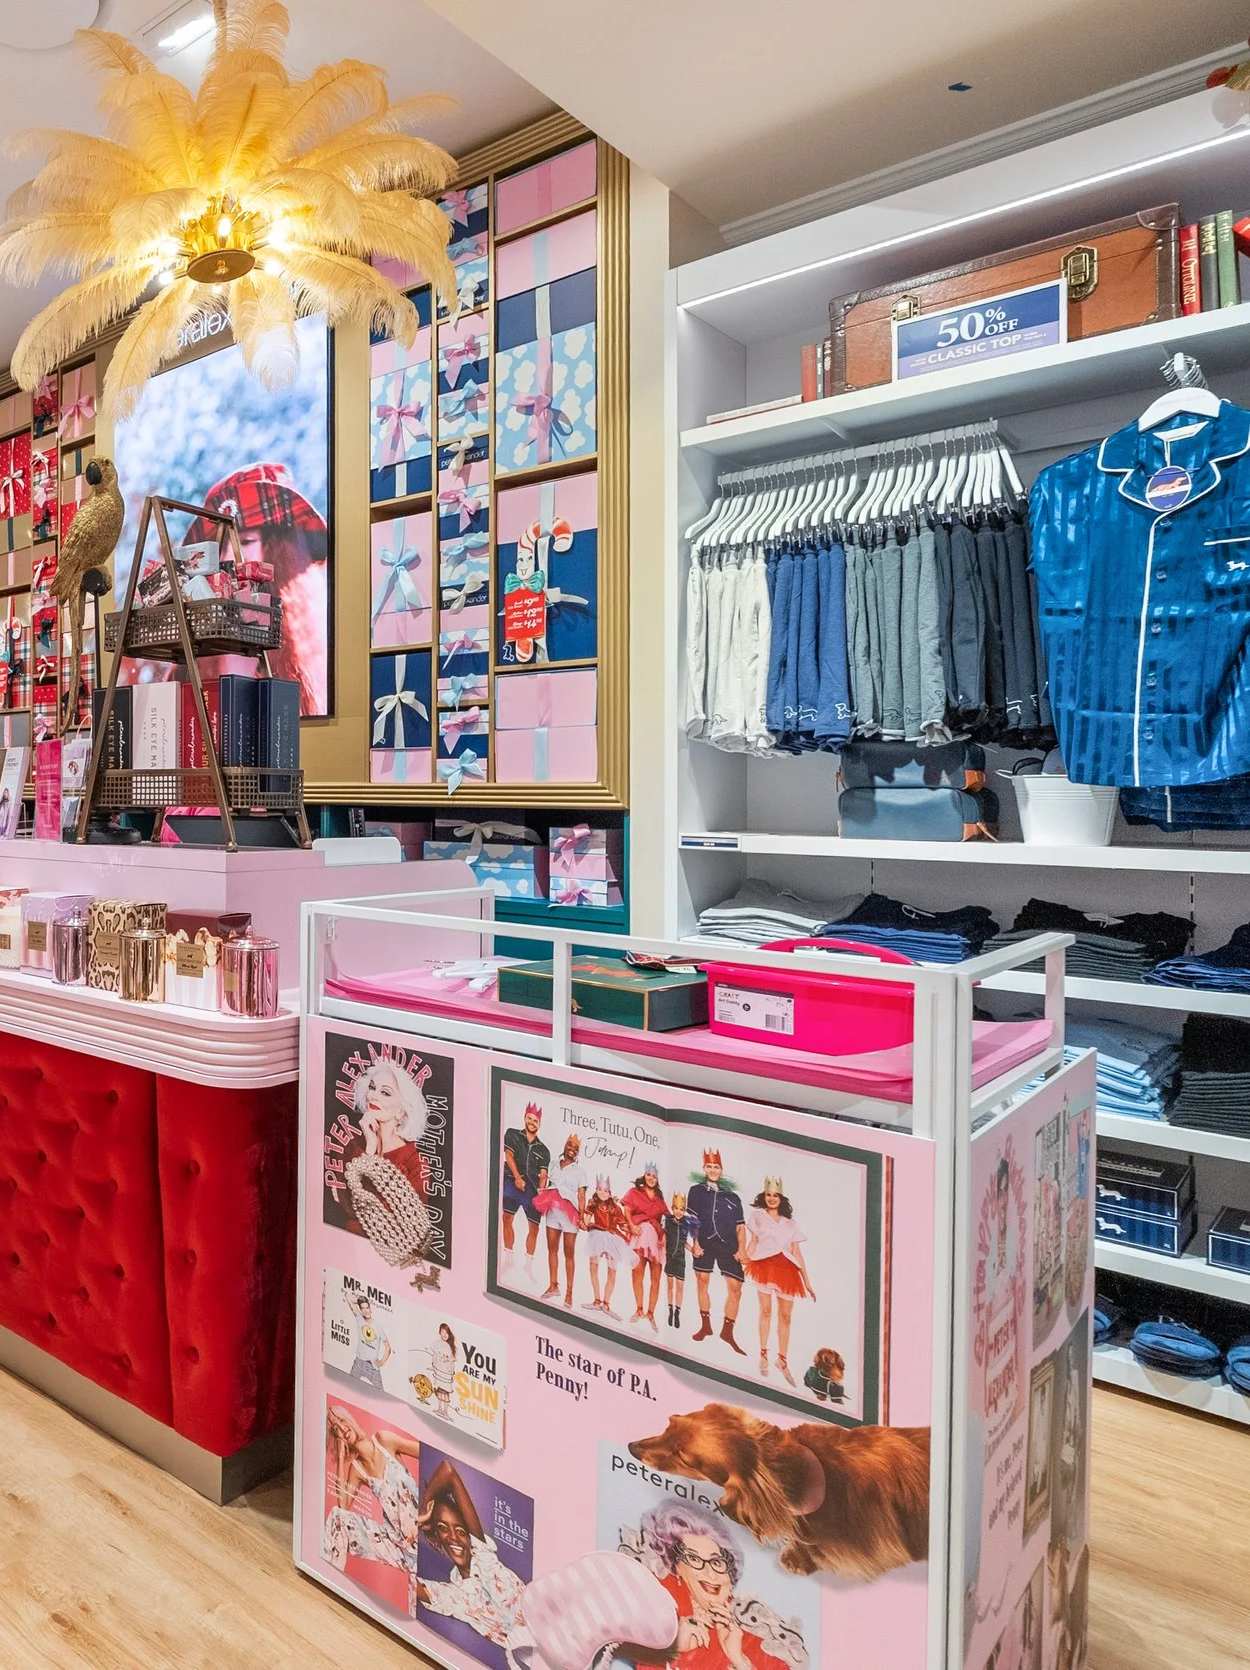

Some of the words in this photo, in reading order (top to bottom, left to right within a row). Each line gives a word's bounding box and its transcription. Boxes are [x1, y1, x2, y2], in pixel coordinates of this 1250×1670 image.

[984, 318, 1019, 336] OFF
[927, 342, 987, 364] CLASSIC
[989, 333, 1022, 349] TOP
[335, 1042, 433, 1110] ALEXANDER
[324, 1114, 362, 1190] PETER
[584, 1136, 636, 1169] Jump!
[424, 1205, 447, 1260] DAY
[367, 1285, 392, 1307] MEN
[331, 1319, 350, 1336] LITTLE
[331, 1330, 350, 1346] MISS
[462, 1364, 480, 1379] ARE
[483, 1373, 497, 1386] MY
[535, 1335, 564, 1362] The
[568, 1353, 602, 1378] star
[607, 1367, 626, 1388] of
[630, 1372, 657, 1401] P.A.
[536, 1361, 588, 1401] Penny!
[459, 1398, 496, 1424] SHINE
[611, 1454, 726, 1517] peteralex
[494, 1496, 512, 1514] it's
[494, 1510, 505, 1525] in
[509, 1519, 529, 1537] the
[494, 1527, 524, 1549] stars
